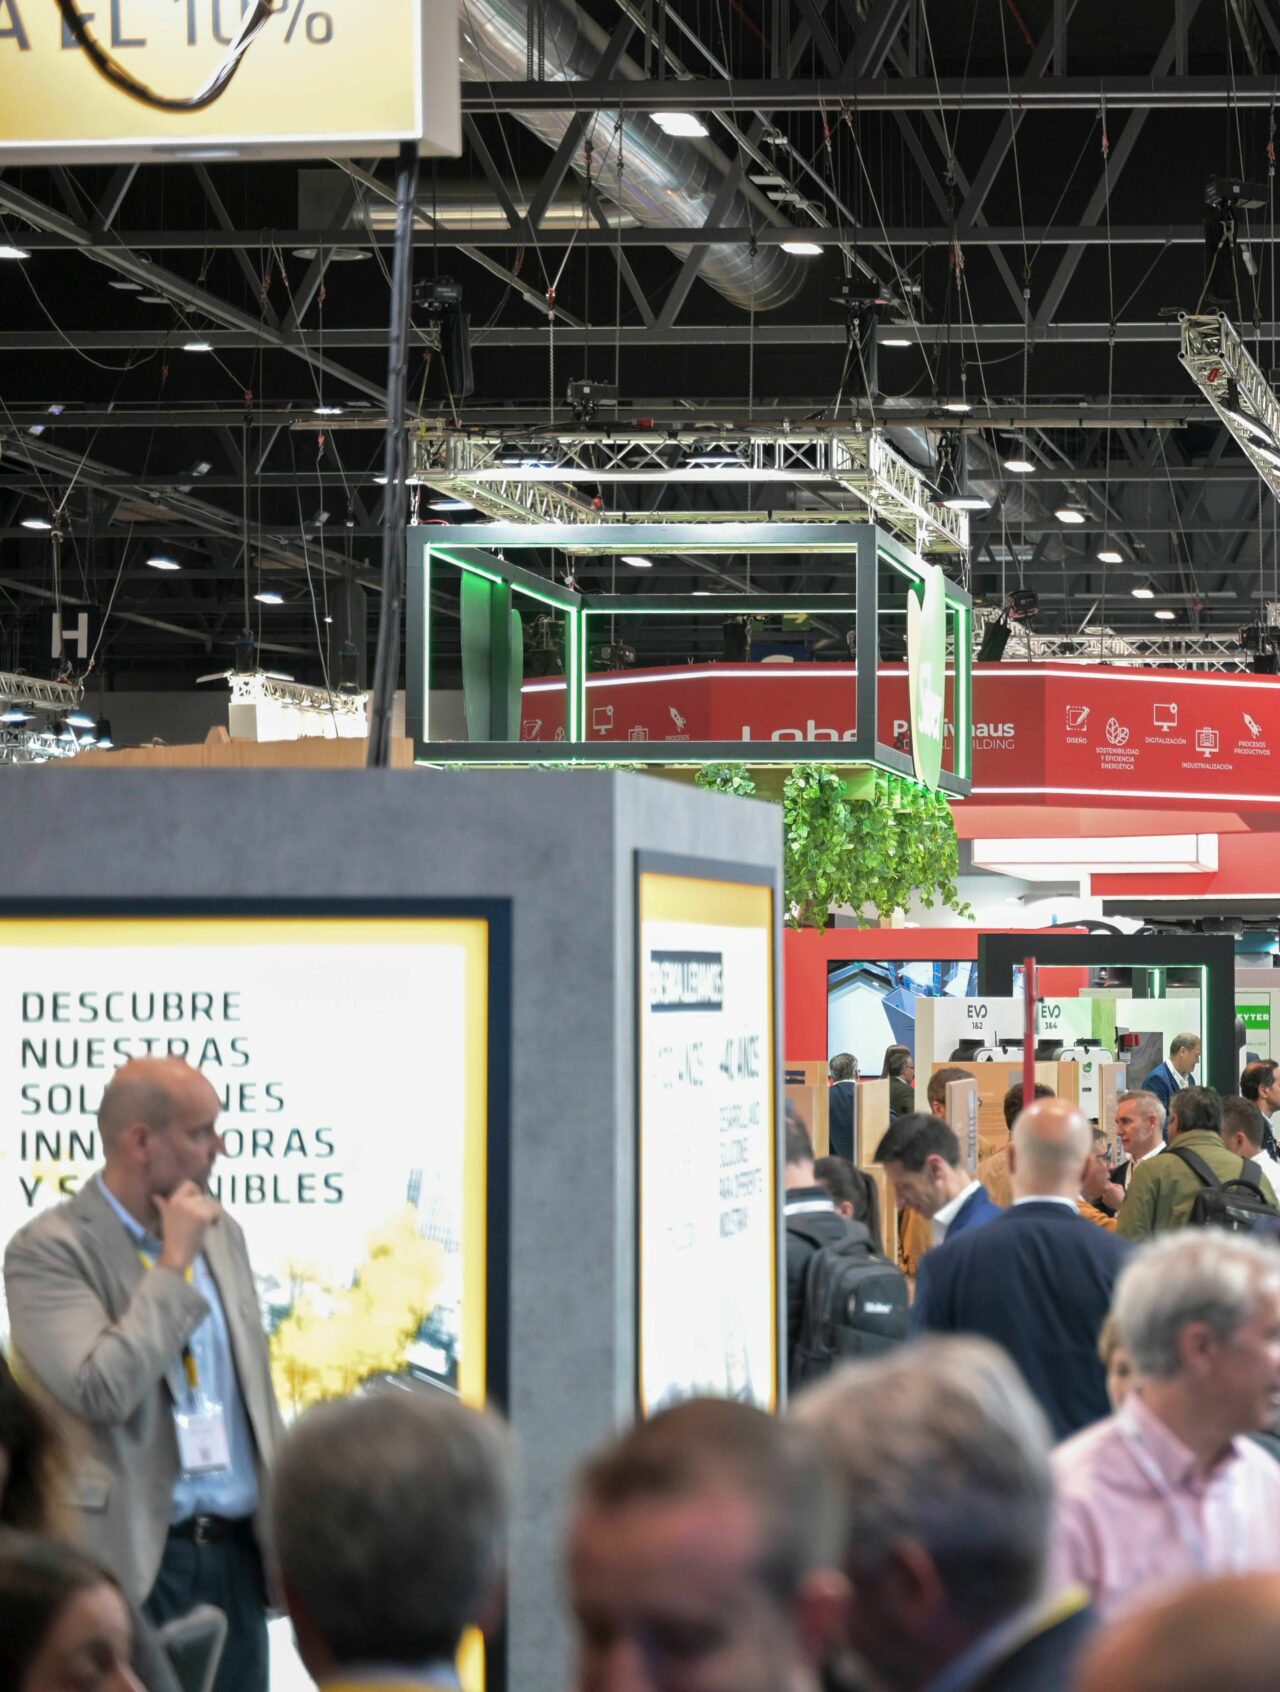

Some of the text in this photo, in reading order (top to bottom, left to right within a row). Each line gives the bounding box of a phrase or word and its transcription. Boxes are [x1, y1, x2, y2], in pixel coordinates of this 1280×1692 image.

[51, 612, 88, 659] H
[1066, 736, 1088, 744] DISEÑO
[1145, 736, 1187, 745] DIGITALIZACIÓN
[1238, 740, 1266, 748] PROCESOS
[1096, 747, 1140, 755] SOSTENIBILIDAD
[1233, 748, 1271, 756] PRODUCTIVOS
[1101, 762, 1135, 771] ENERGÉTICA
[1181, 762, 1233, 771] INDUSTRIALIZACIÓN
[21, 991, 242, 1023] DESCUBRE
[967, 1004, 988, 1019] EVO
[1040, 1004, 1061, 1019] EVO
[972, 1021, 984, 1030] 1&2
[1044, 1021, 1058, 1030] 3&4
[21, 1036, 251, 1069] NUESTRAS
[19, 1175, 43, 1207] Y
